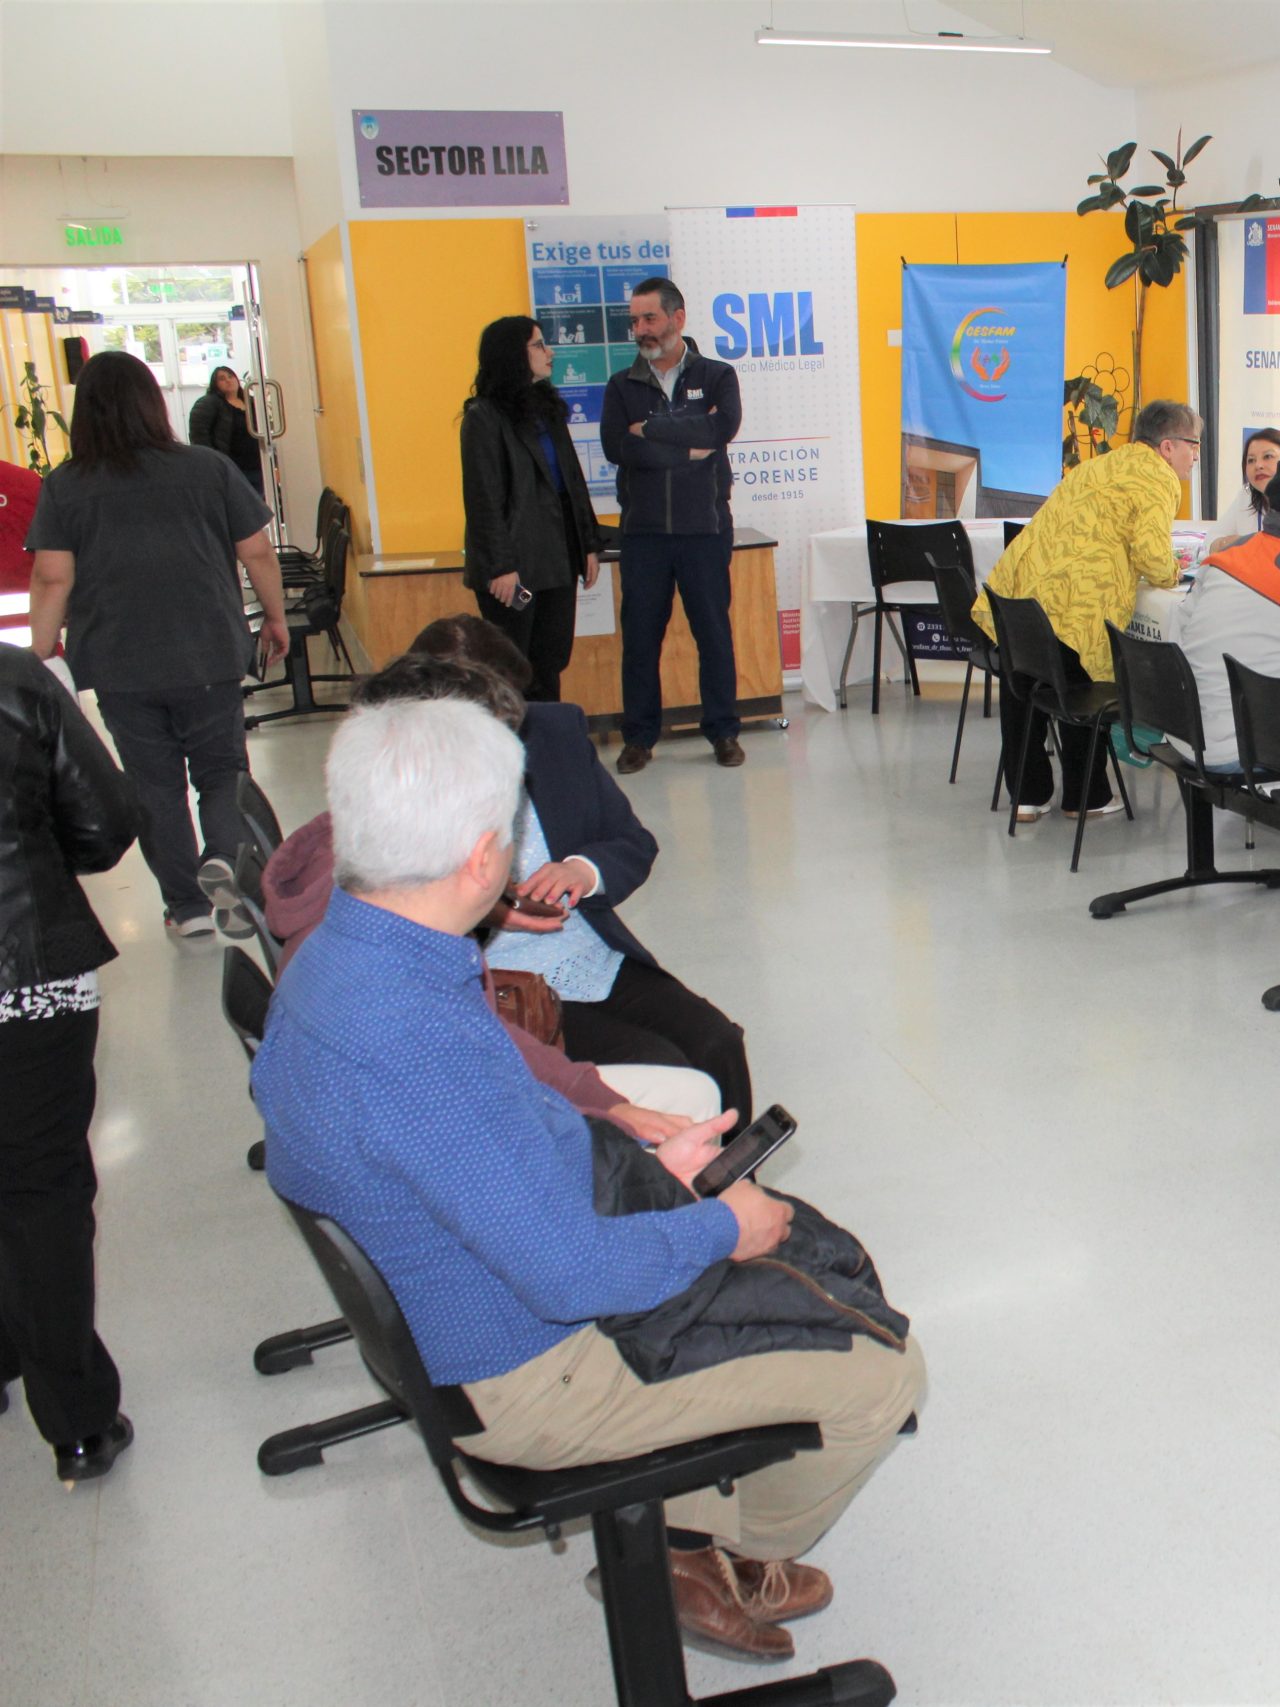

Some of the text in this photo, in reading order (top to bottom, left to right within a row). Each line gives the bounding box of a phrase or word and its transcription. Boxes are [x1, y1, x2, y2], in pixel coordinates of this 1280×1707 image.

[376, 145, 549, 176] SECTOR LILA
[65, 227, 123, 247] SALIDA
[532, 241, 592, 265] Exige
[597, 243, 632, 260] tus
[712, 291, 825, 360] SML
[966, 326, 1016, 337] CESFAM
[760, 360, 795, 372] Médico
[799, 359, 825, 372] Legal
[729, 446, 820, 464] TRADICIÓN
[731, 467, 818, 486] FORENSE
[752, 490, 804, 502] desde 1915
